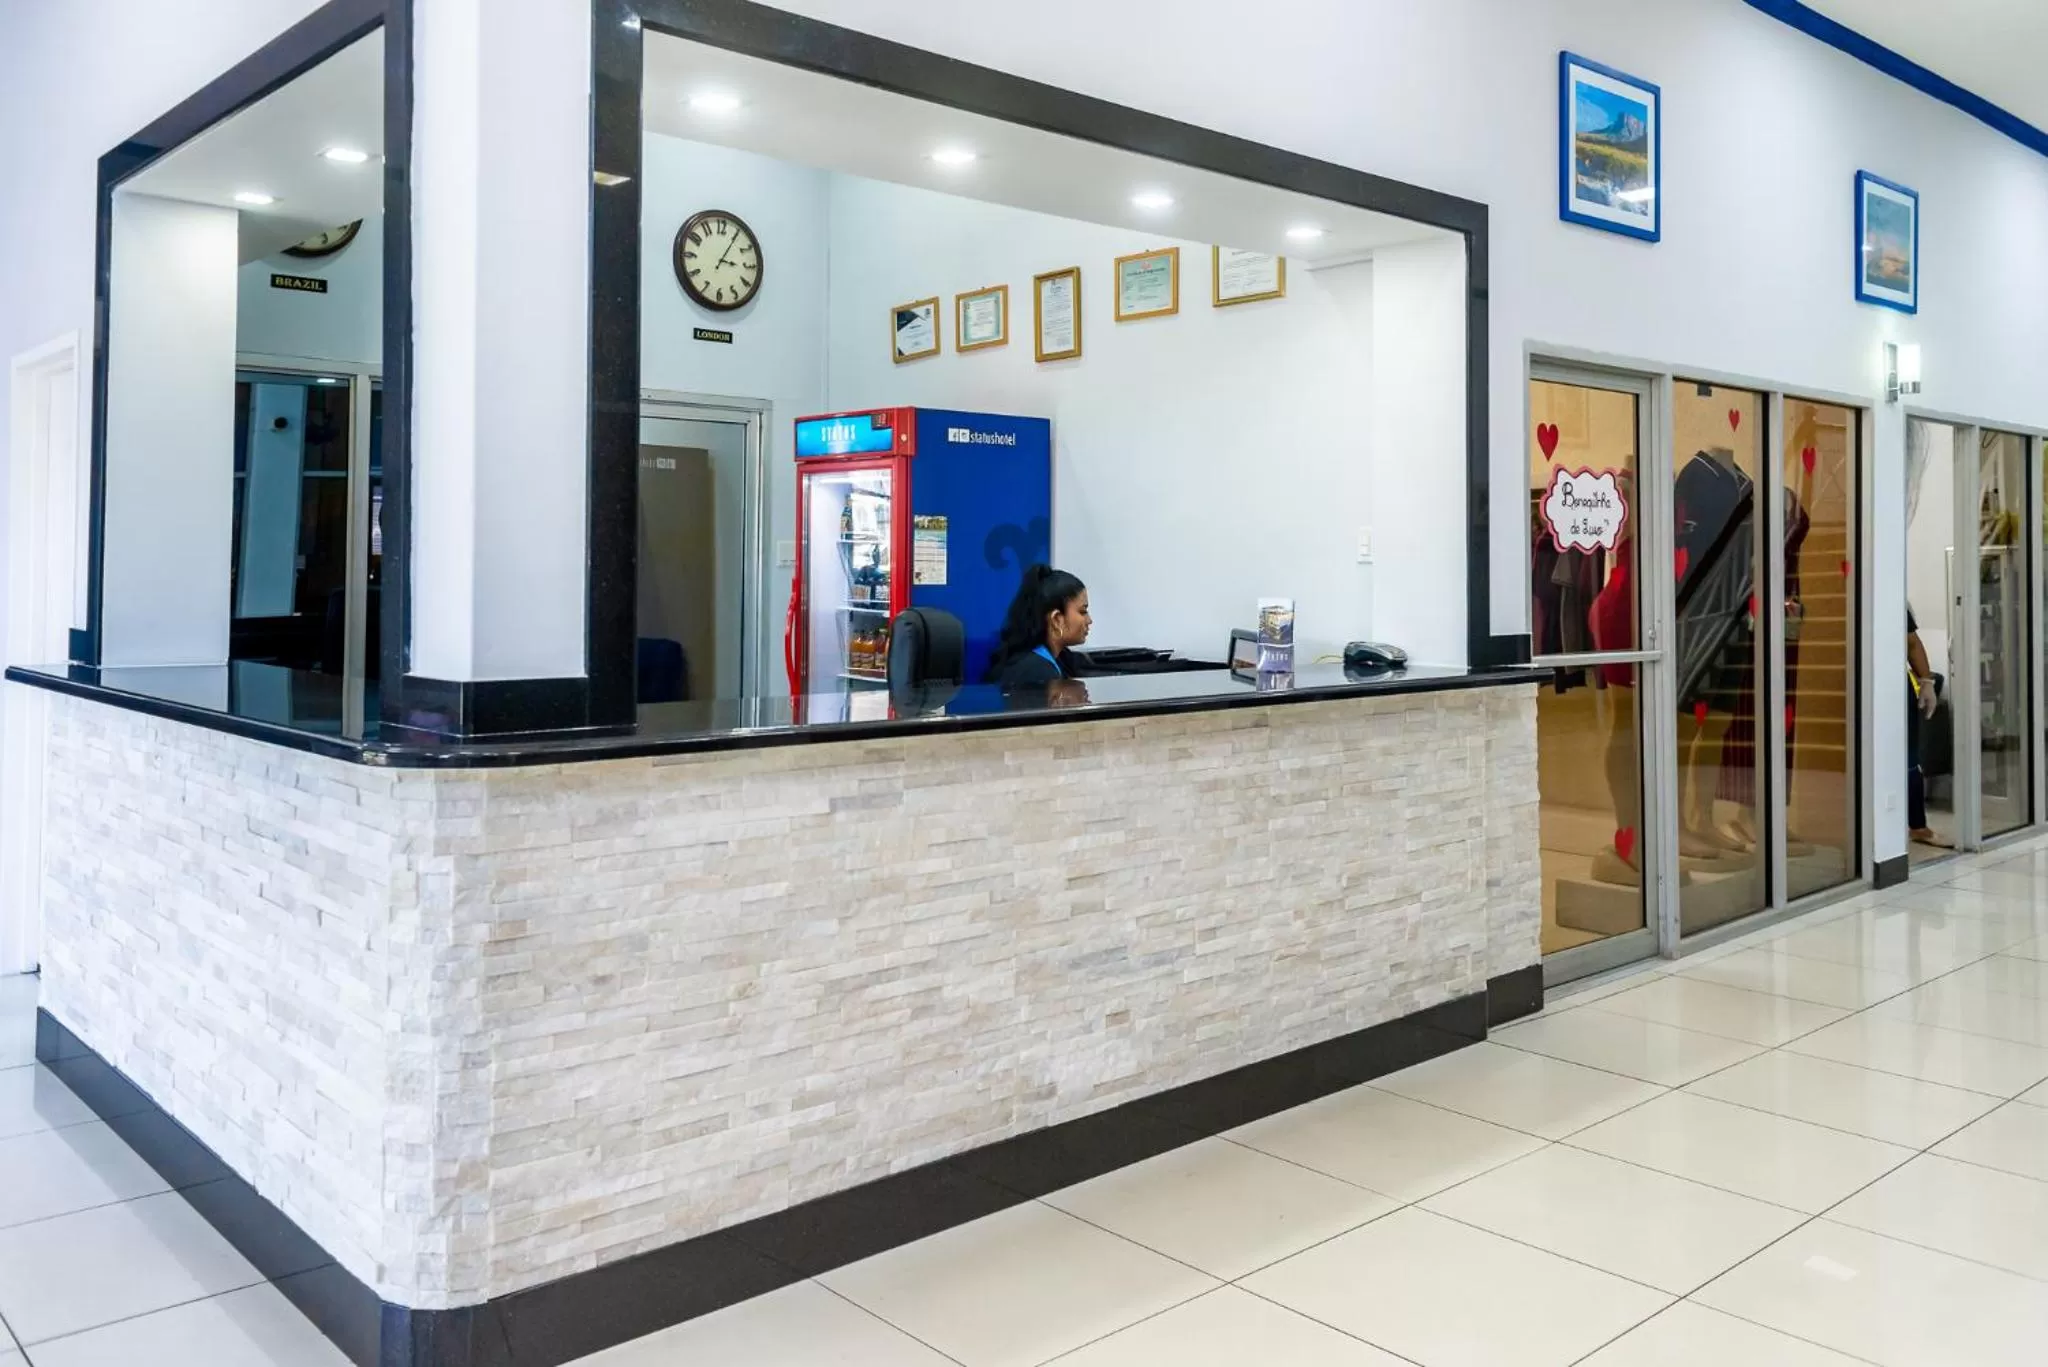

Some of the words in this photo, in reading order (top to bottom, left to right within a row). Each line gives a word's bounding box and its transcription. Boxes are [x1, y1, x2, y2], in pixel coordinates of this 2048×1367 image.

[701, 220, 712, 237] 11
[716, 219, 727, 235] 12
[740, 244, 753, 253] 2
[742, 262, 757, 270] 3
[275, 276, 323, 290] BRAZIL
[701, 280, 710, 294] 7
[740, 276, 752, 287] 4
[716, 287, 724, 302] 6
[729, 285, 739, 300] 5
[696, 330, 731, 342] LONDON
[1570, 519, 1580, 534] de
